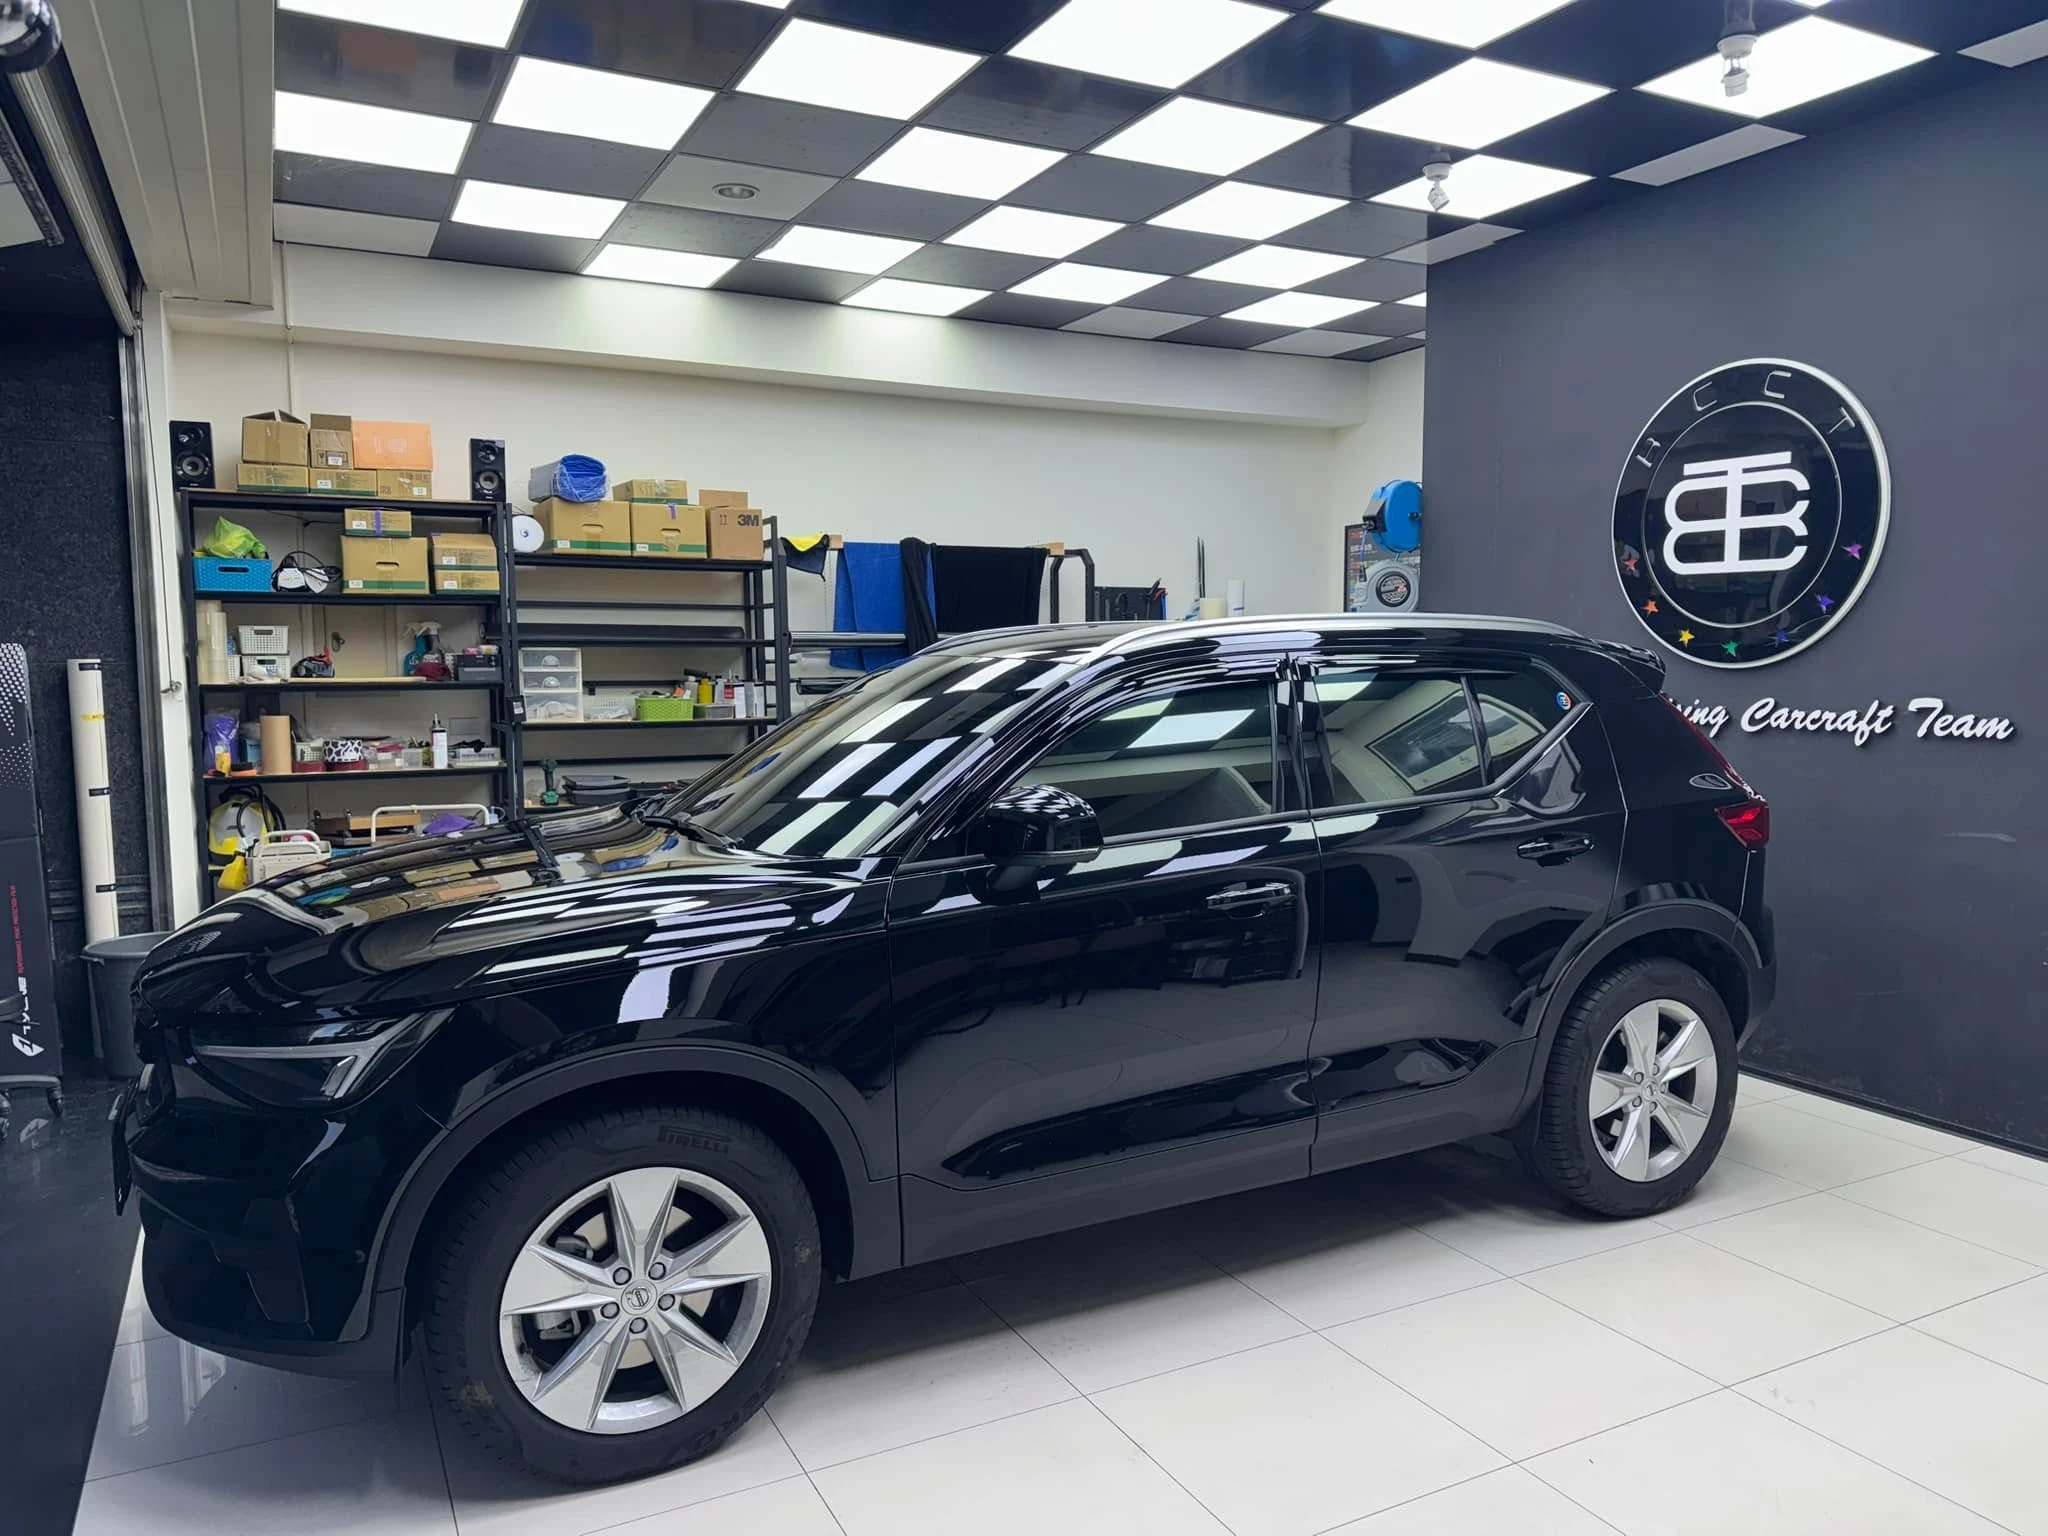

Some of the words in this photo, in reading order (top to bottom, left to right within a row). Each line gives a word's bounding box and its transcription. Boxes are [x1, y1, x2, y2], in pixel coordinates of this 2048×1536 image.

[737, 514, 760, 527] 3M
[1740, 697, 1893, 746] Carcraft
[1908, 697, 2013, 740] Team
[657, 1125, 732, 1154] PIRELLI
